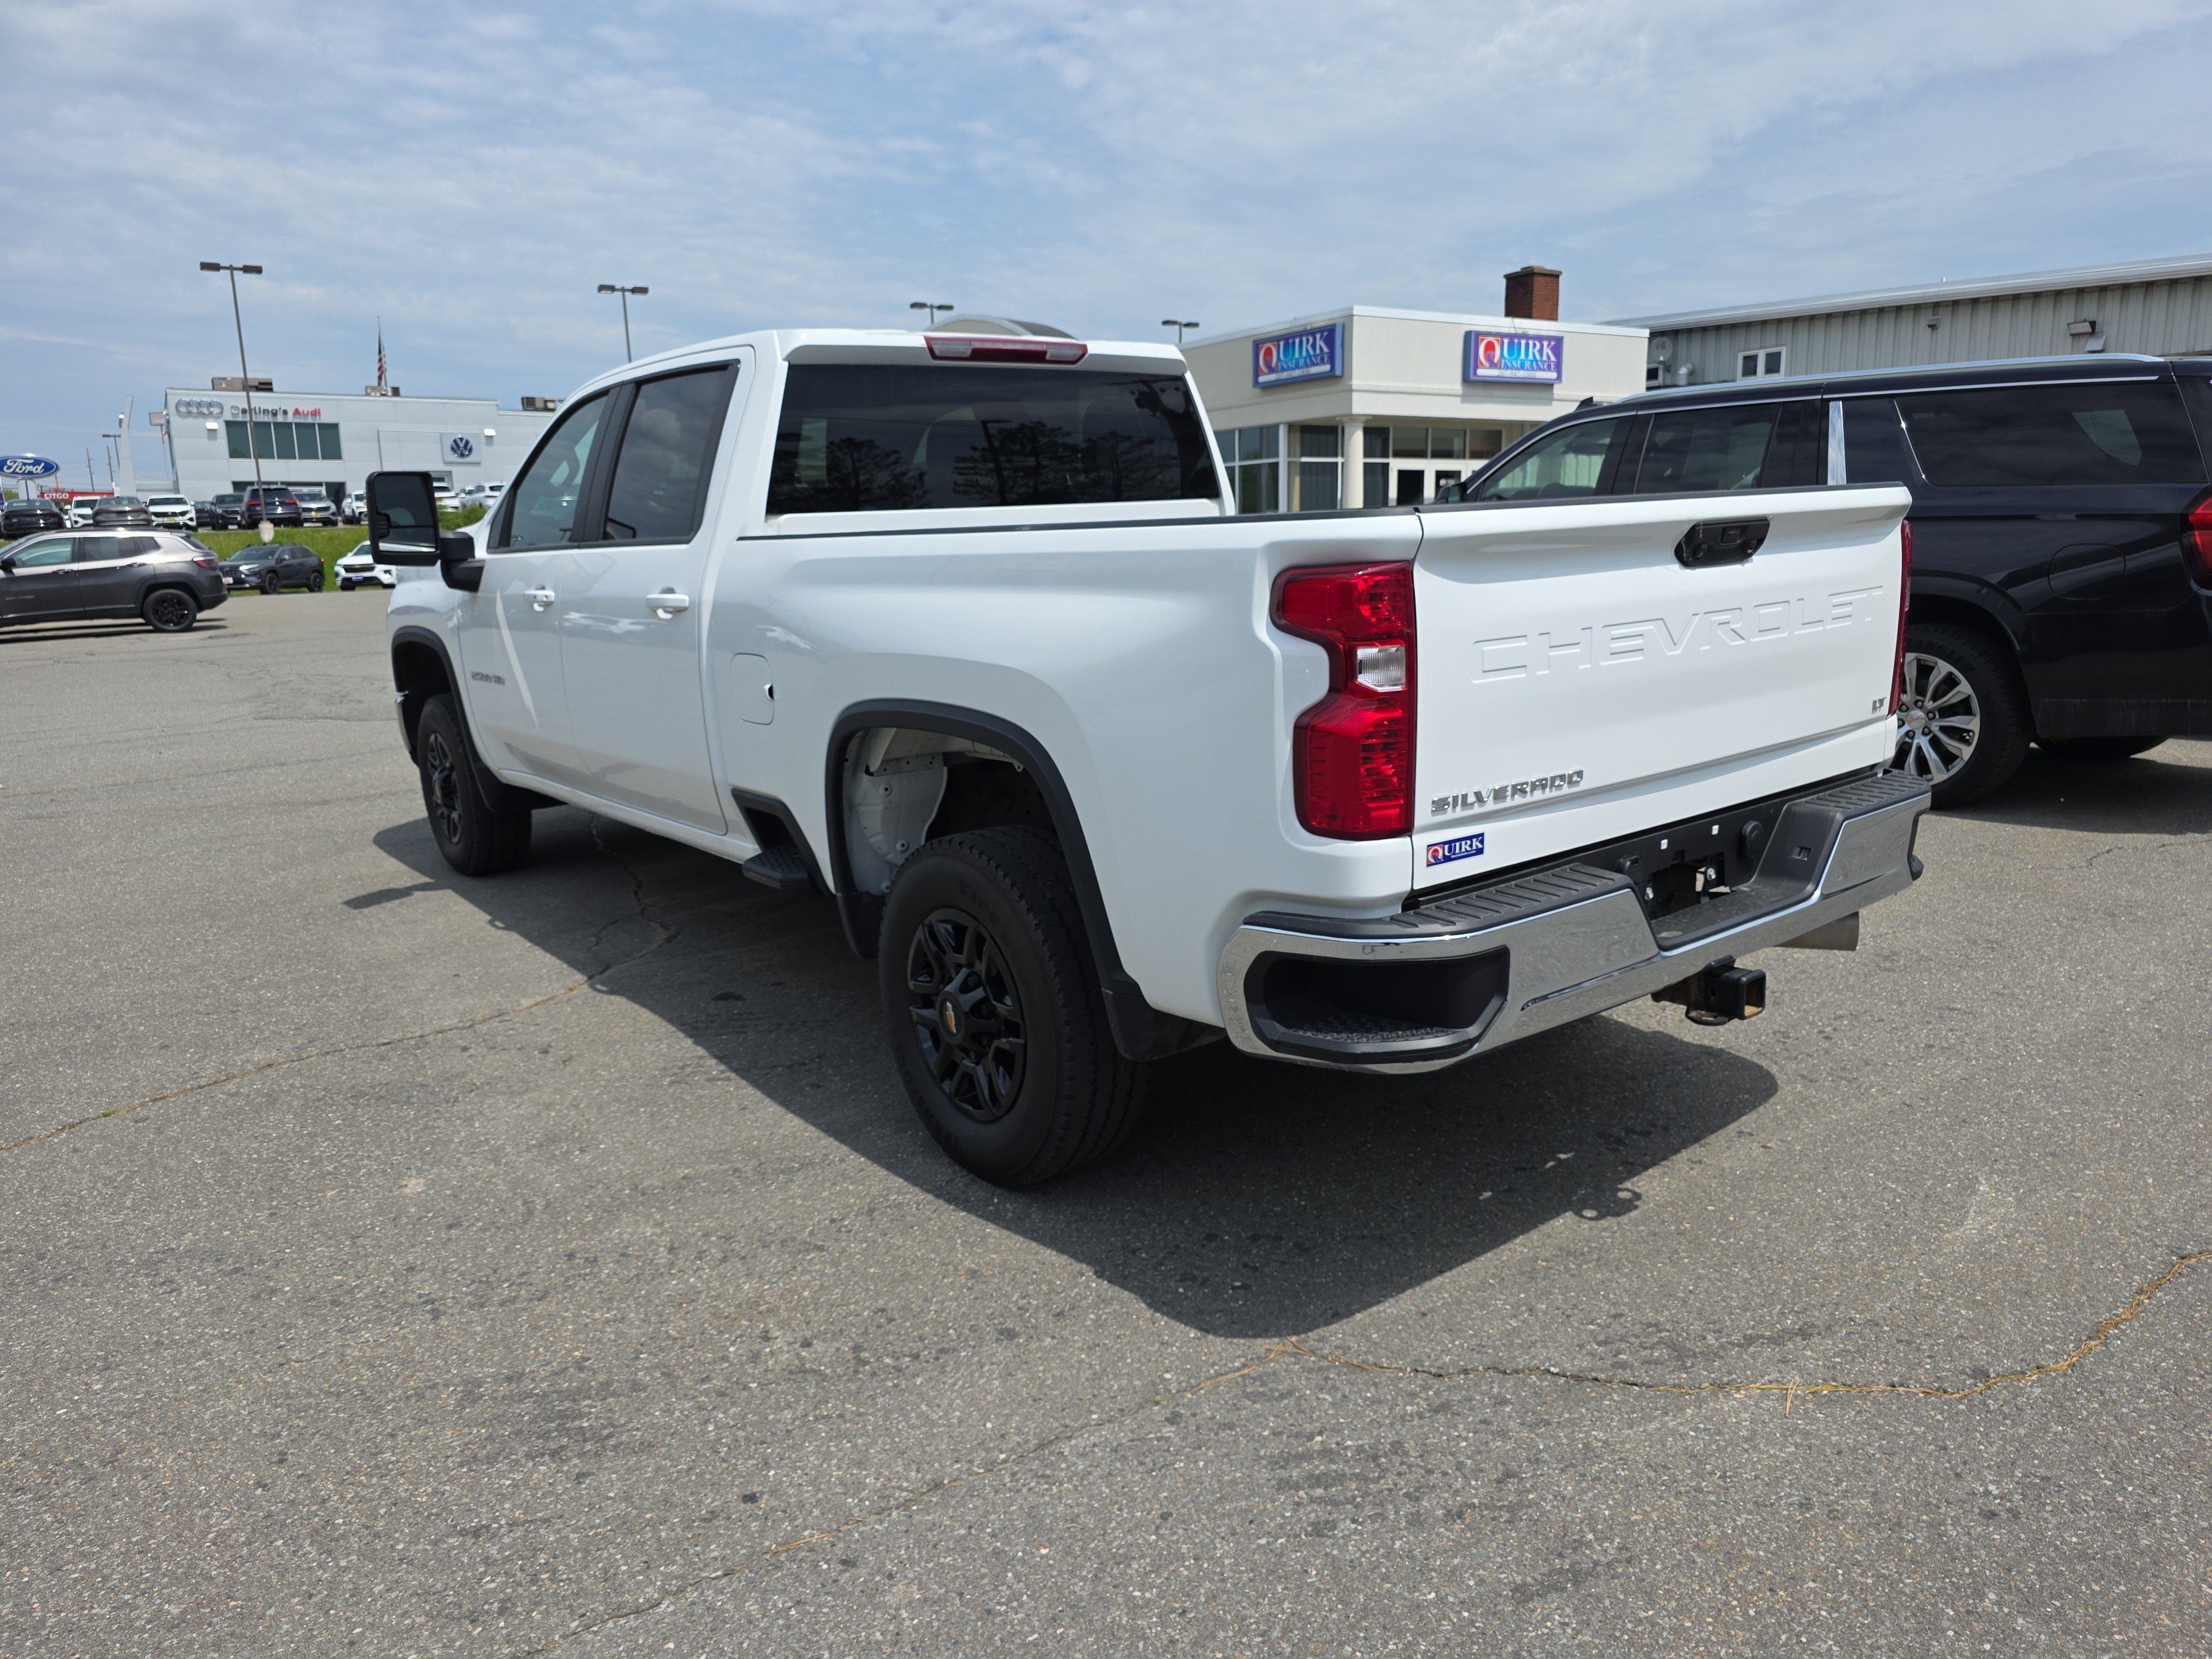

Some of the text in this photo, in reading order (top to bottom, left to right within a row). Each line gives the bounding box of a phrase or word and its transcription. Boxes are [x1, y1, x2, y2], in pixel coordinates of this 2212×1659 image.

[1259, 332, 1329, 373] QUIRK
[1278, 353, 1330, 371] INSURANCE
[1478, 337, 1557, 367] QUIRK
[1501, 359, 1557, 371] INSURANCE
[292, 408, 321, 416] Audi
[3, 458, 44, 474] Ford
[1471, 585, 1883, 683] CHEVROLET
[1872, 697, 1886, 714] LT
[1431, 769, 1583, 812] SILVERADO
[1427, 837, 1483, 863] QUIRK
